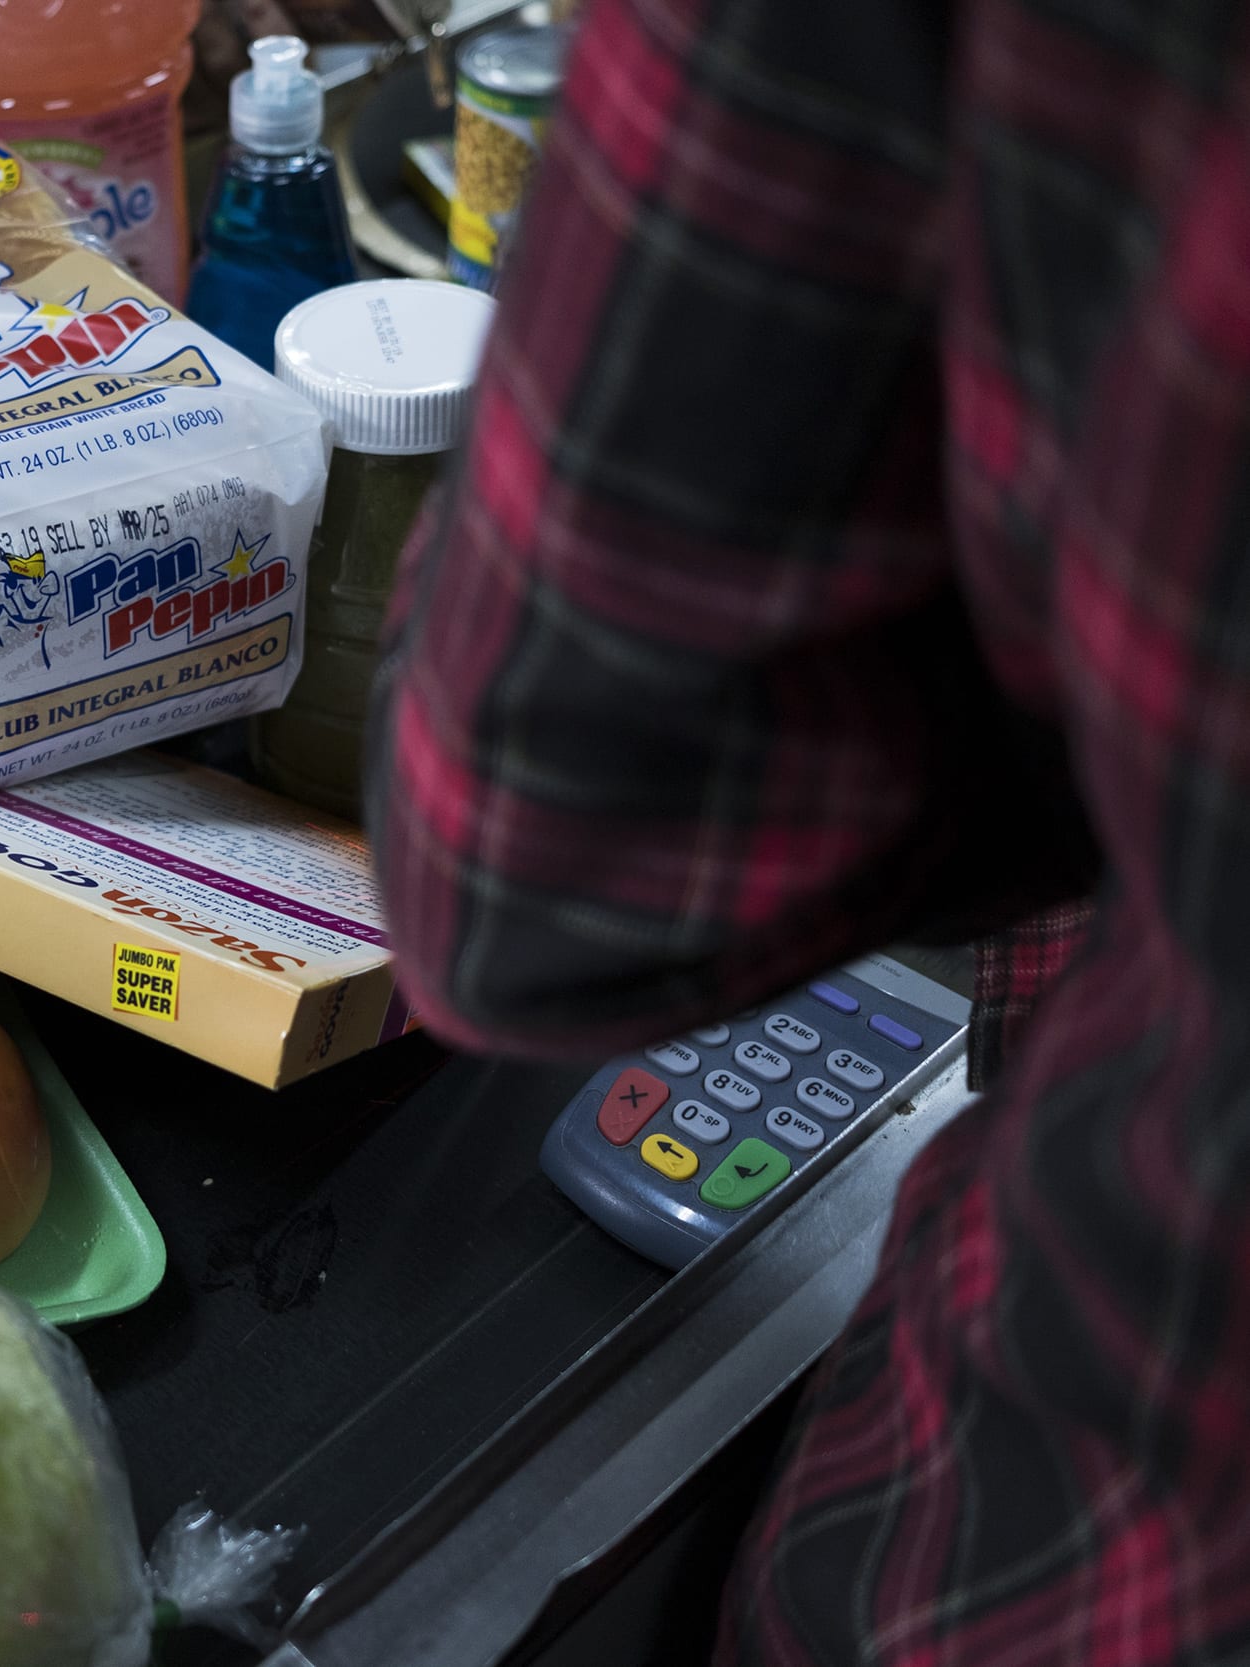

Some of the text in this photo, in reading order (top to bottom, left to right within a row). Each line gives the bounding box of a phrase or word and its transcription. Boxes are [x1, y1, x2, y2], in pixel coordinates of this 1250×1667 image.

[29, 419, 72, 436] GRAIN
[73, 408, 119, 424] WHITE
[119, 393, 166, 412] BREAD
[21, 454, 44, 473] 24
[45, 446, 74, 466] OZ.
[76, 441, 92, 461] (1
[94, 433, 122, 453] LB.
[123, 429, 135, 446] 8
[136, 420, 172, 442] OZ.)
[172, 406, 224, 436] (680g)
[46, 520, 85, 553] SELL
[89, 514, 111, 548] BY
[117, 504, 170, 541] MAR/25
[71, 547, 196, 616] Pan
[108, 562, 285, 652] Pepin
[48, 675, 169, 724] INTEGRAL
[177, 637, 278, 684] BLANCO
[62, 741, 81, 754] 24
[116, 839, 165, 862] more
[161, 856, 208, 880] add
[204, 872, 250, 896] will
[252, 886, 339, 930] product
[102, 888, 306, 974] Sazón
[335, 918, 381, 944] This
[118, 948, 176, 974] JUMBO PAK
[116, 967, 173, 995] SUPER
[116, 987, 172, 1014] SAVER
[771, 1018, 814, 1041] 2 ABC
[670, 1046, 692, 1061] PRS
[744, 1045, 782, 1067] 5 JKL
[833, 1053, 877, 1077] 3 DEF
[713, 1074, 754, 1097] 8 TUV
[806, 1080, 850, 1107] 6 MNO
[681, 1105, 700, 1122] 0
[774, 1111, 819, 1137] 9 WXY
